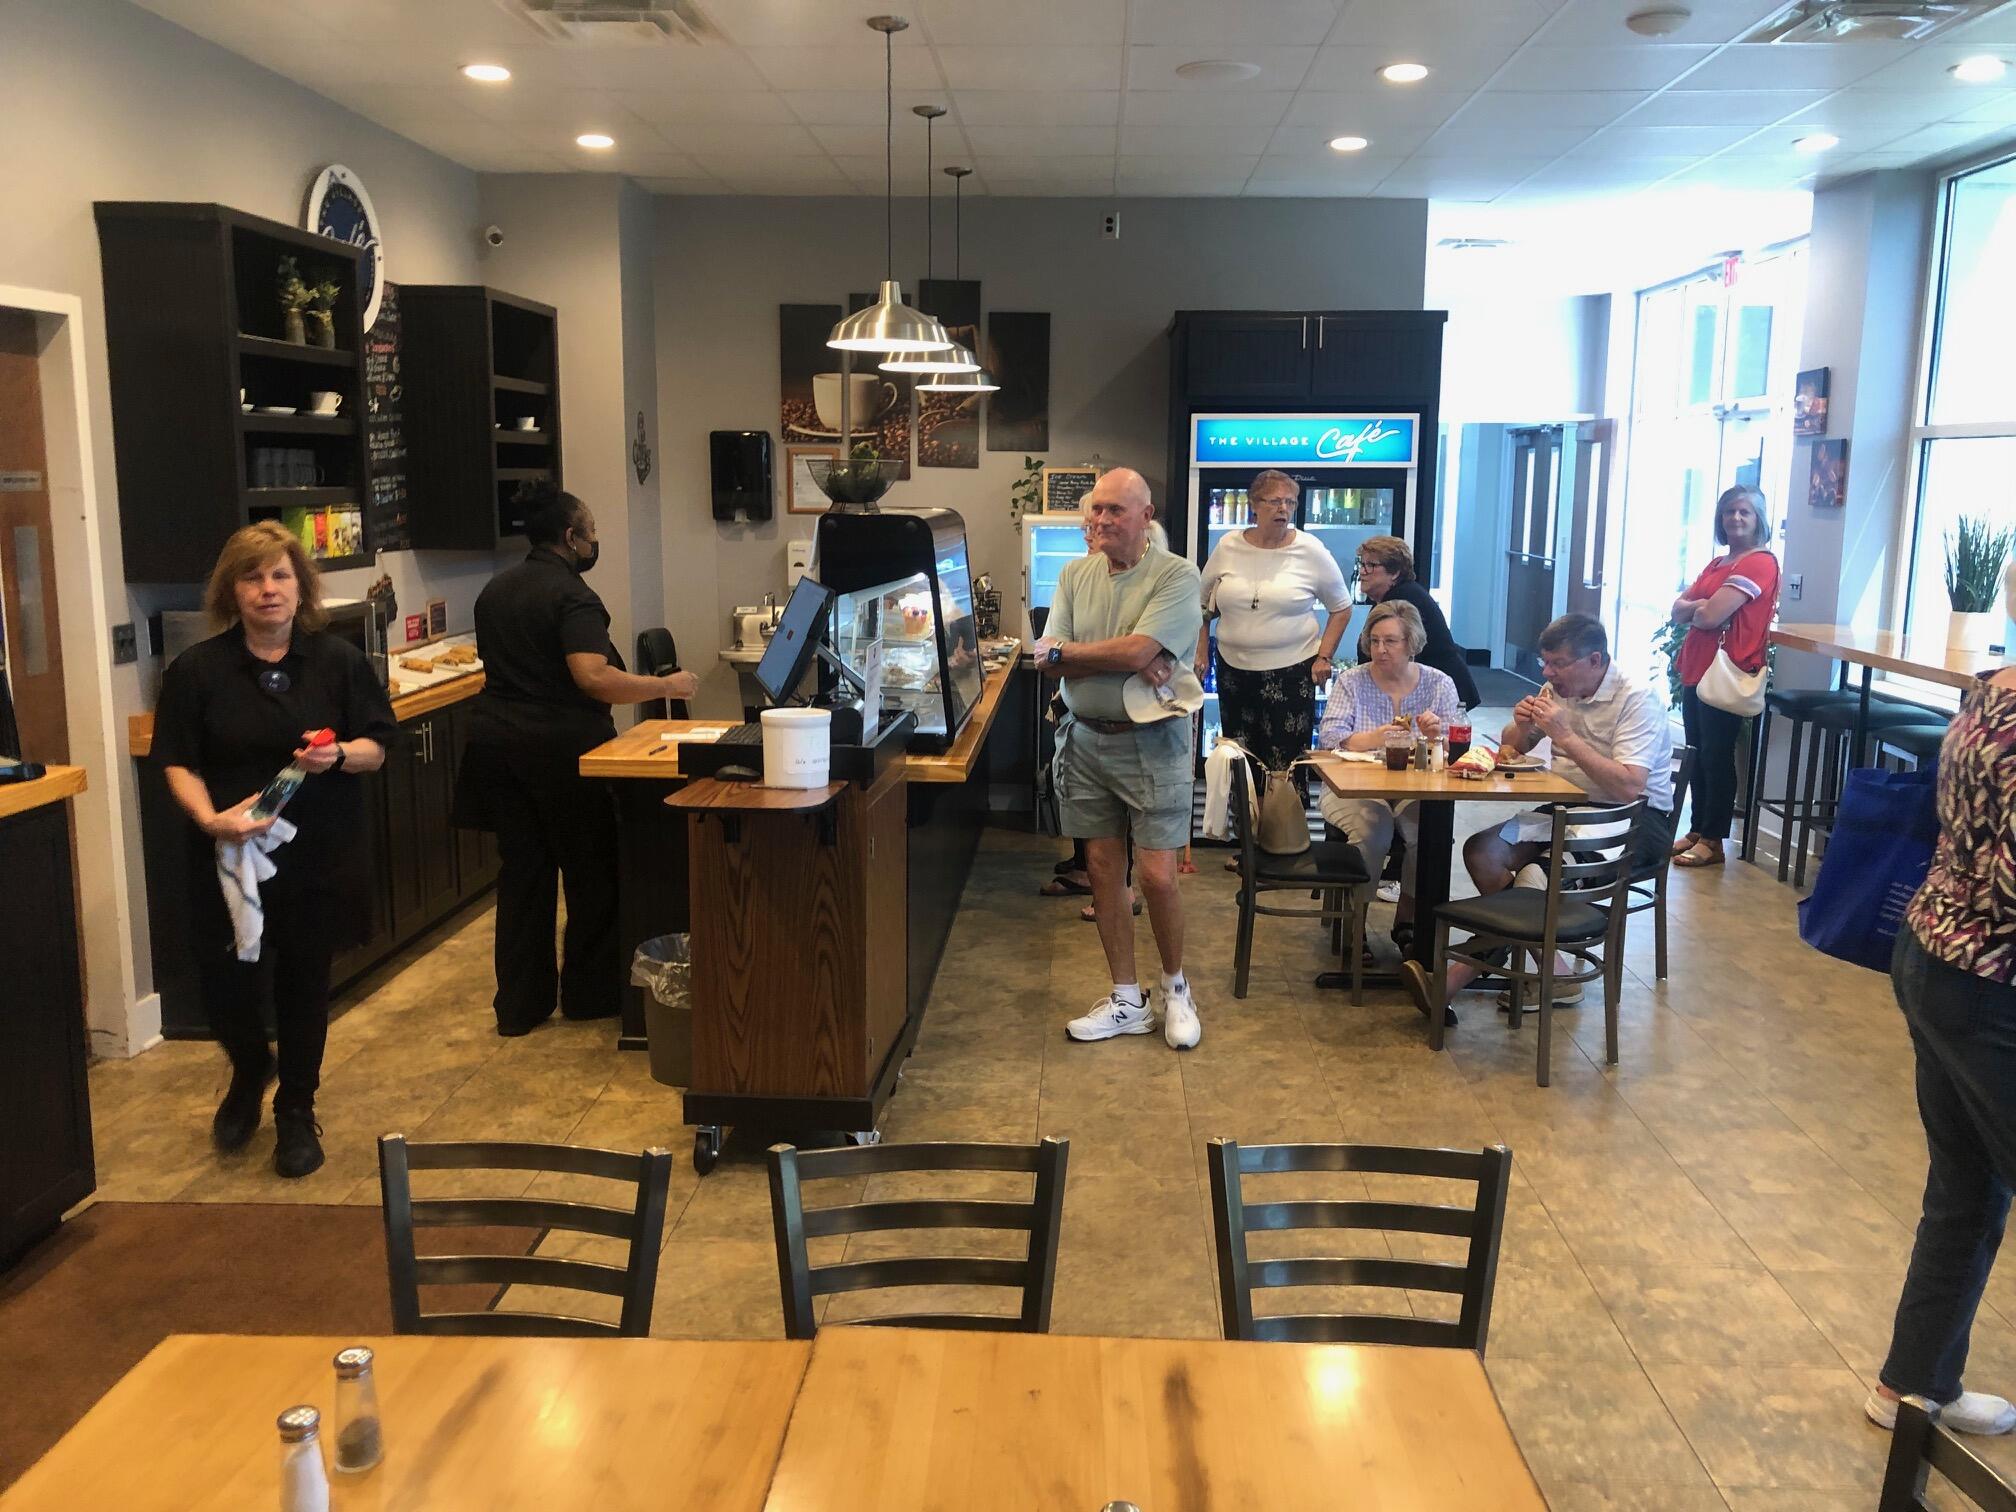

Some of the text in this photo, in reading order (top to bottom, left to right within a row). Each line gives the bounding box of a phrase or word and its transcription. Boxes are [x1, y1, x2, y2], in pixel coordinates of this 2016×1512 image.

[1209, 420, 1401, 463] THE VILLAGE Café
